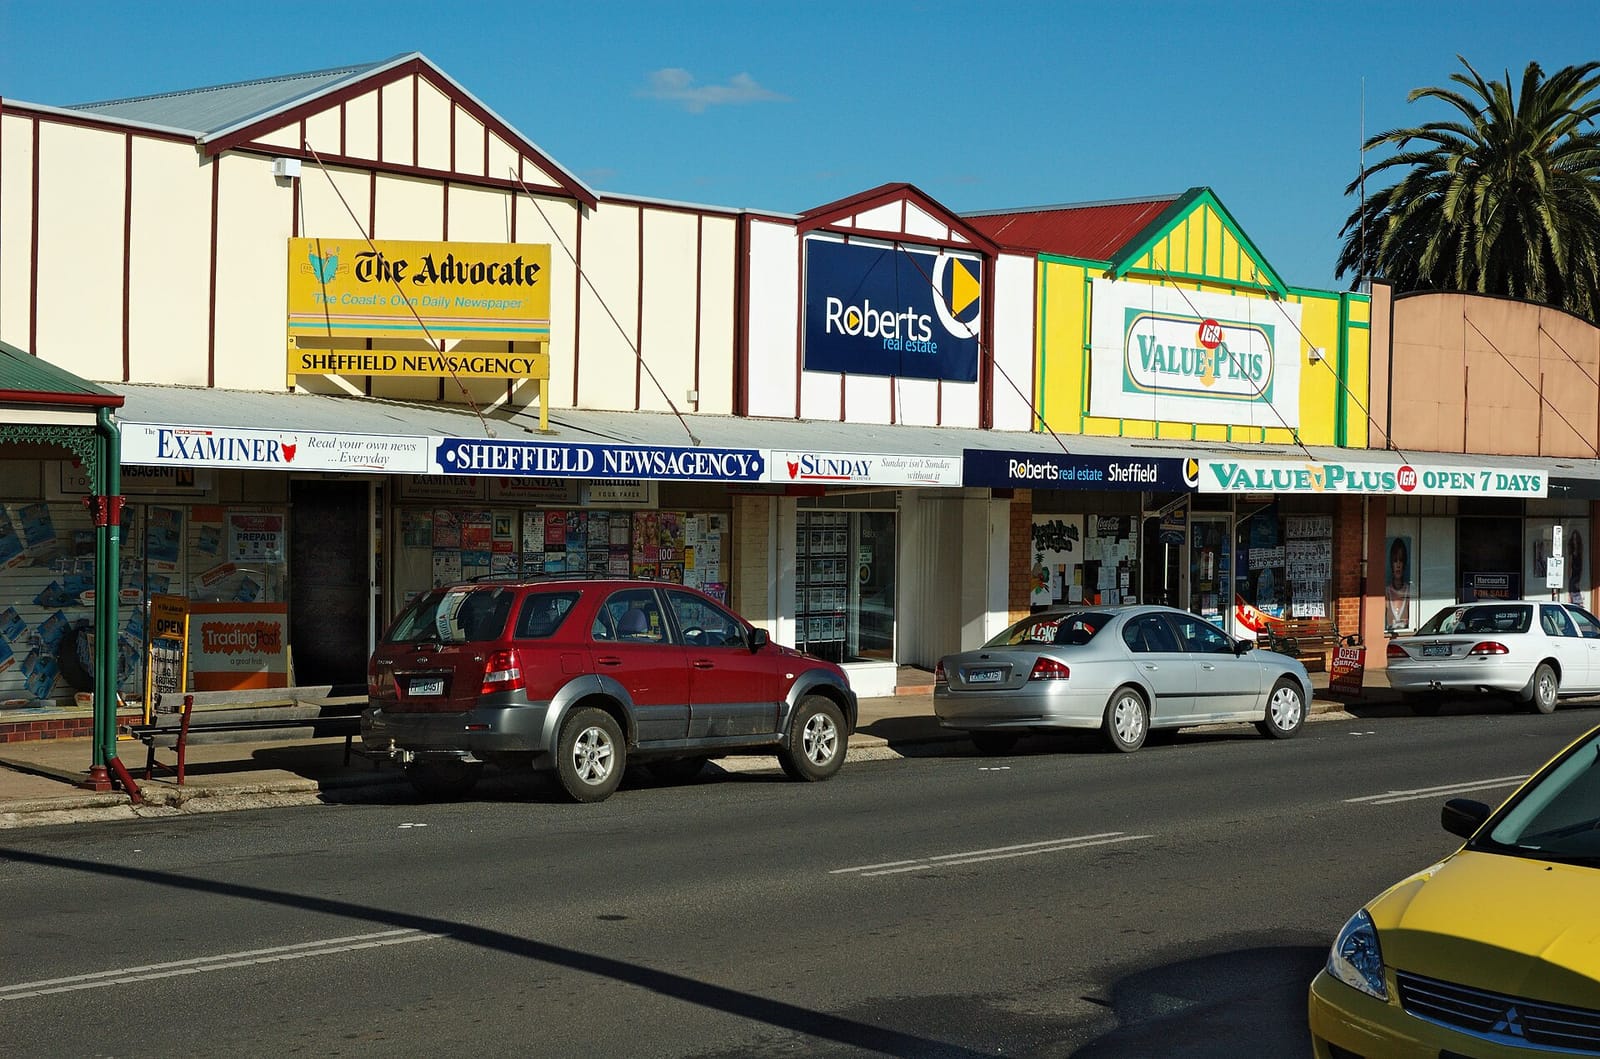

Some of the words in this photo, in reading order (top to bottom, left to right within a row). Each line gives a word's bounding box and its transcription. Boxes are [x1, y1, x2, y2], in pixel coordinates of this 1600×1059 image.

[355, 251, 409, 283] The
[412, 253, 541, 287] Advocate
[391, 295, 418, 307] Own
[422, 296, 451, 309] Daily
[826, 296, 932, 343] Roberts
[1201, 323, 1222, 343] IGA
[883, 336, 903, 351] real
[906, 339, 938, 354] estate
[301, 353, 397, 372] SHEFFIELD
[403, 356, 535, 374] NEWSAGENCY
[1137, 334, 1207, 377] VALUE
[1213, 341, 1263, 382] PLUS
[157, 429, 280, 462] EXAMINER
[308, 436, 337, 448] Read
[339, 440, 364, 452] your
[366, 441, 388, 451] own
[391, 443, 416, 452] news
[457, 444, 594, 473] SHEFFIELD
[602, 449, 752, 477] NEWSAGENCY
[801, 453, 873, 476] SUNDAY
[881, 457, 907, 470] Sunday
[909, 458, 923, 468] isn't
[925, 459, 951, 470] Sunday
[907, 471, 933, 480] without
[934, 471, 941, 480] it
[1009, 459, 1058, 481] Roberts
[1059, 467, 1076, 480] real
[1077, 467, 1103, 482] estate
[1108, 460, 1158, 484] Sheffield
[1208, 463, 1311, 491] VALUE
[1323, 465, 1396, 492] PLUS
[1400, 470, 1416, 487] IGA
[1423, 472, 1475, 490] OPEN
[1480, 470, 1490, 492] 7
[1495, 474, 1541, 492] DAYS
[237, 533, 276, 541] PREPAID
[157, 619, 184, 634] OPEN
[1340, 648, 1358, 659] OPEN
